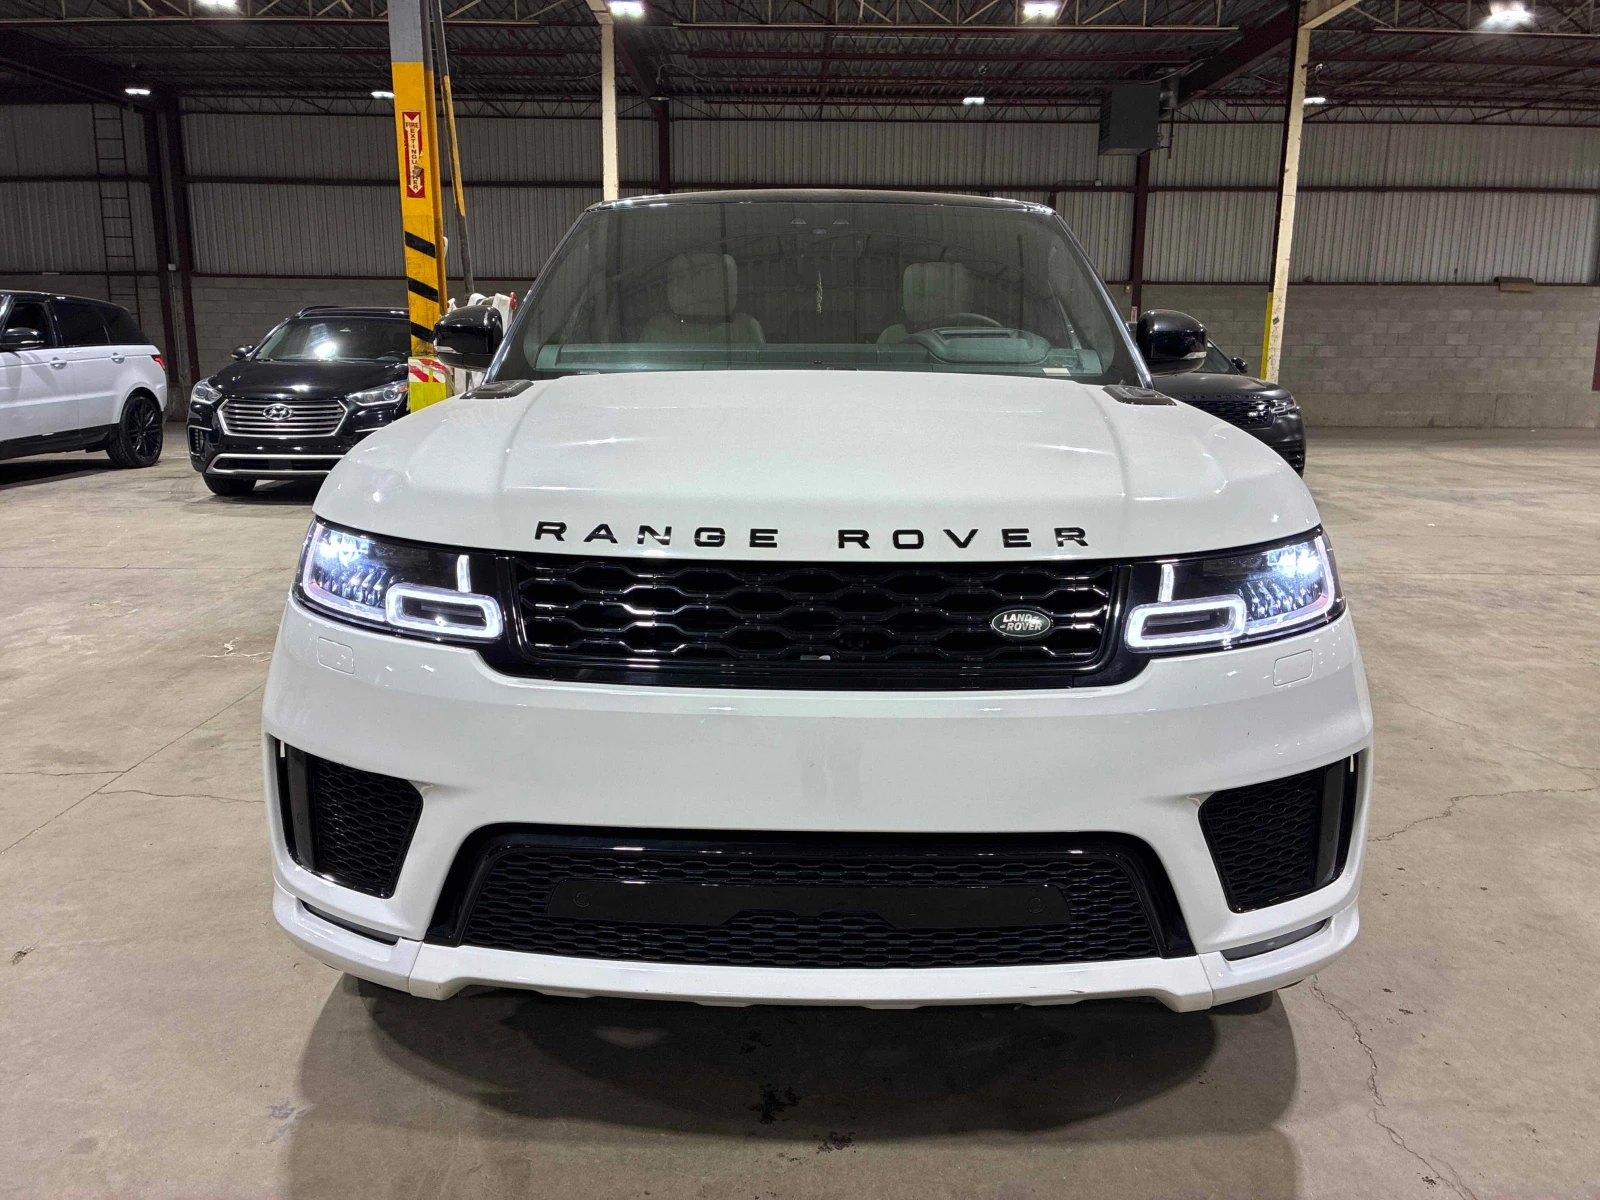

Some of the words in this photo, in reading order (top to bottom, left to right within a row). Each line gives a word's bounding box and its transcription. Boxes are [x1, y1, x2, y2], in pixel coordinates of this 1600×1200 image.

[534, 520, 778, 548] RANGE
[838, 526, 1089, 549] ROVER
[1003, 613, 1033, 622] LAND
[1006, 622, 1043, 631] ROVER
